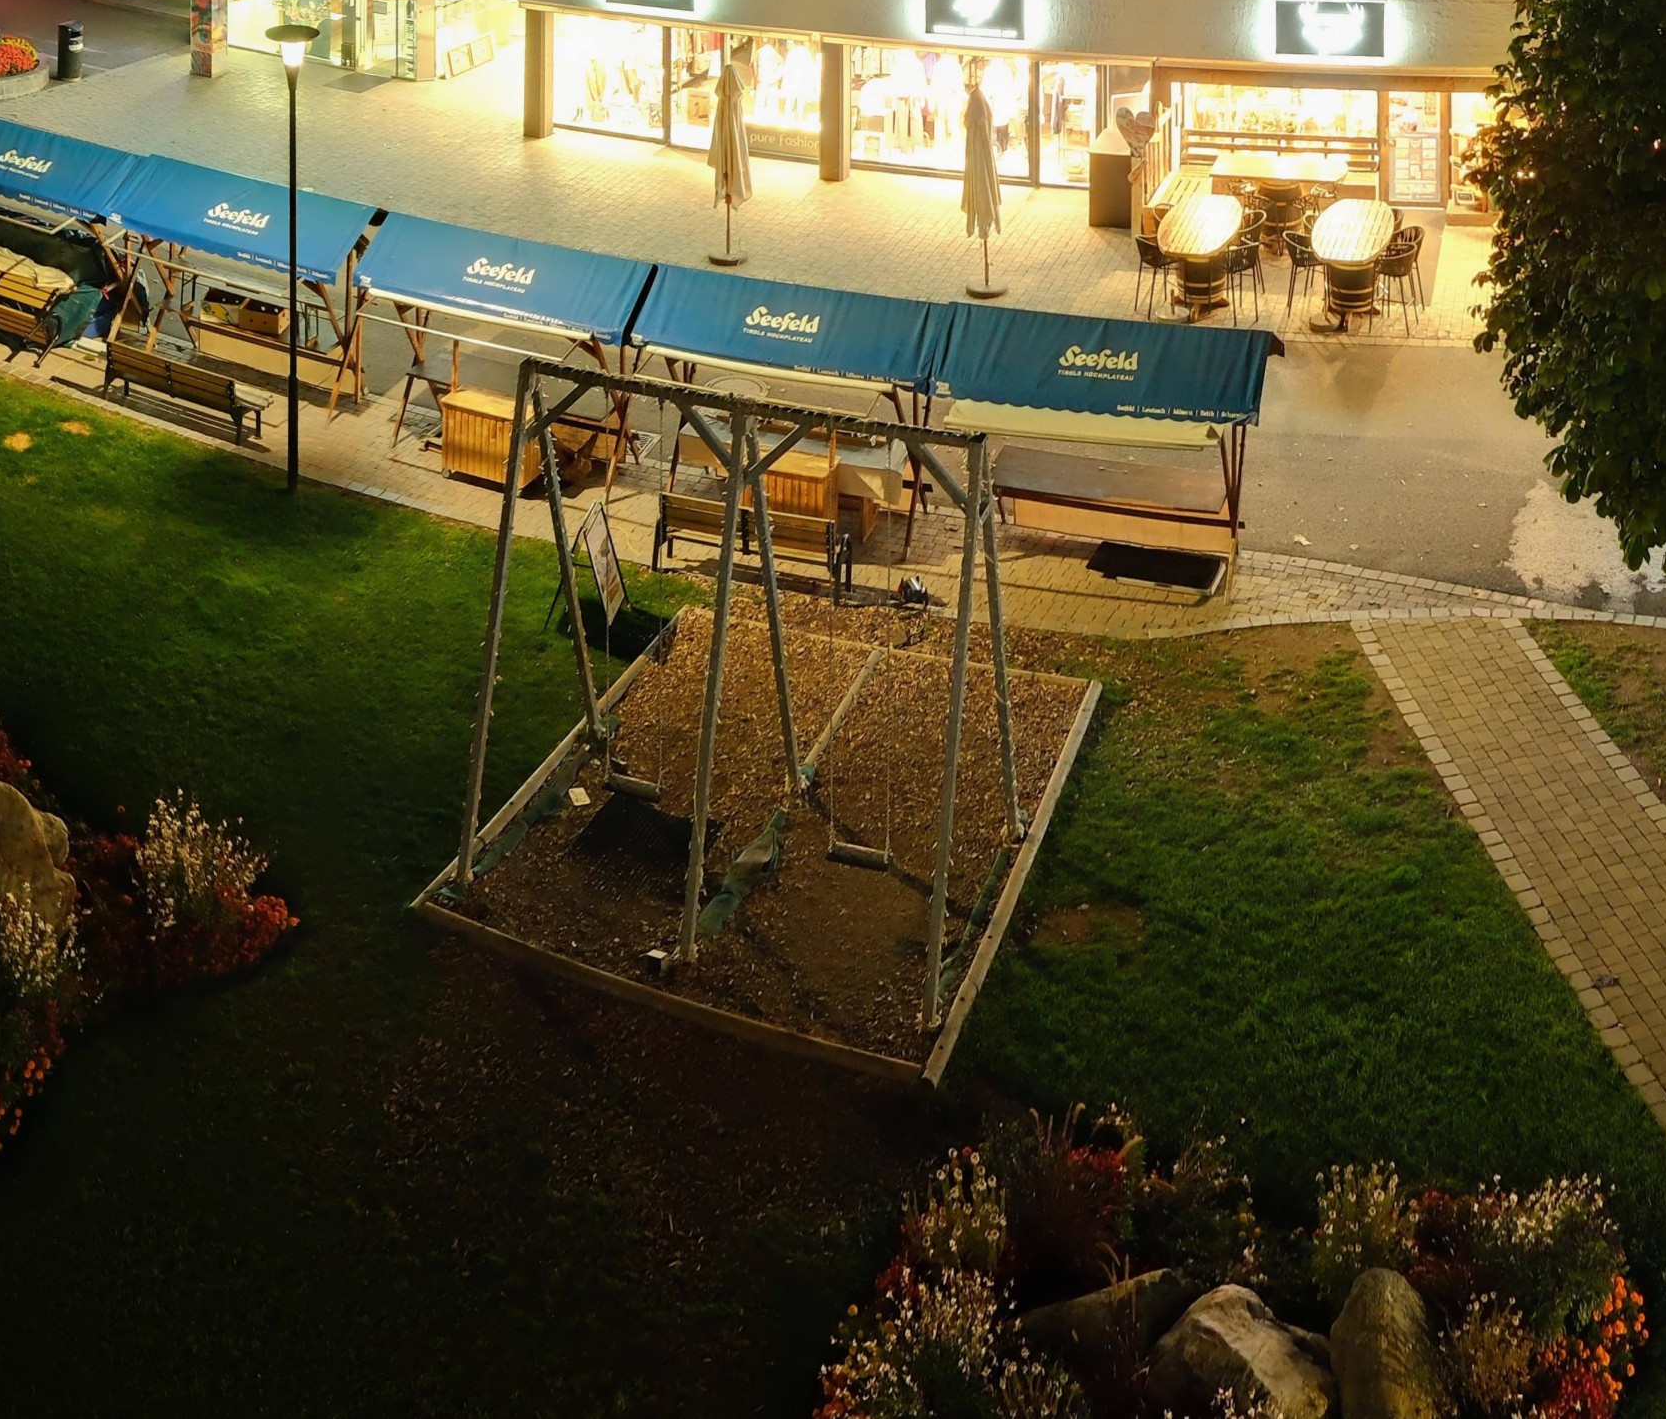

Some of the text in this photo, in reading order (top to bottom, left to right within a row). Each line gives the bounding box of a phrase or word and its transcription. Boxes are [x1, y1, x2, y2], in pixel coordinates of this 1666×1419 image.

[750, 133, 776, 143] pure
[208, 202, 271, 229] Seefeld
[467, 257, 536, 285] Seefeld
[745, 305, 821, 334] Seefeld
[1058, 344, 1139, 372] Seefeld
